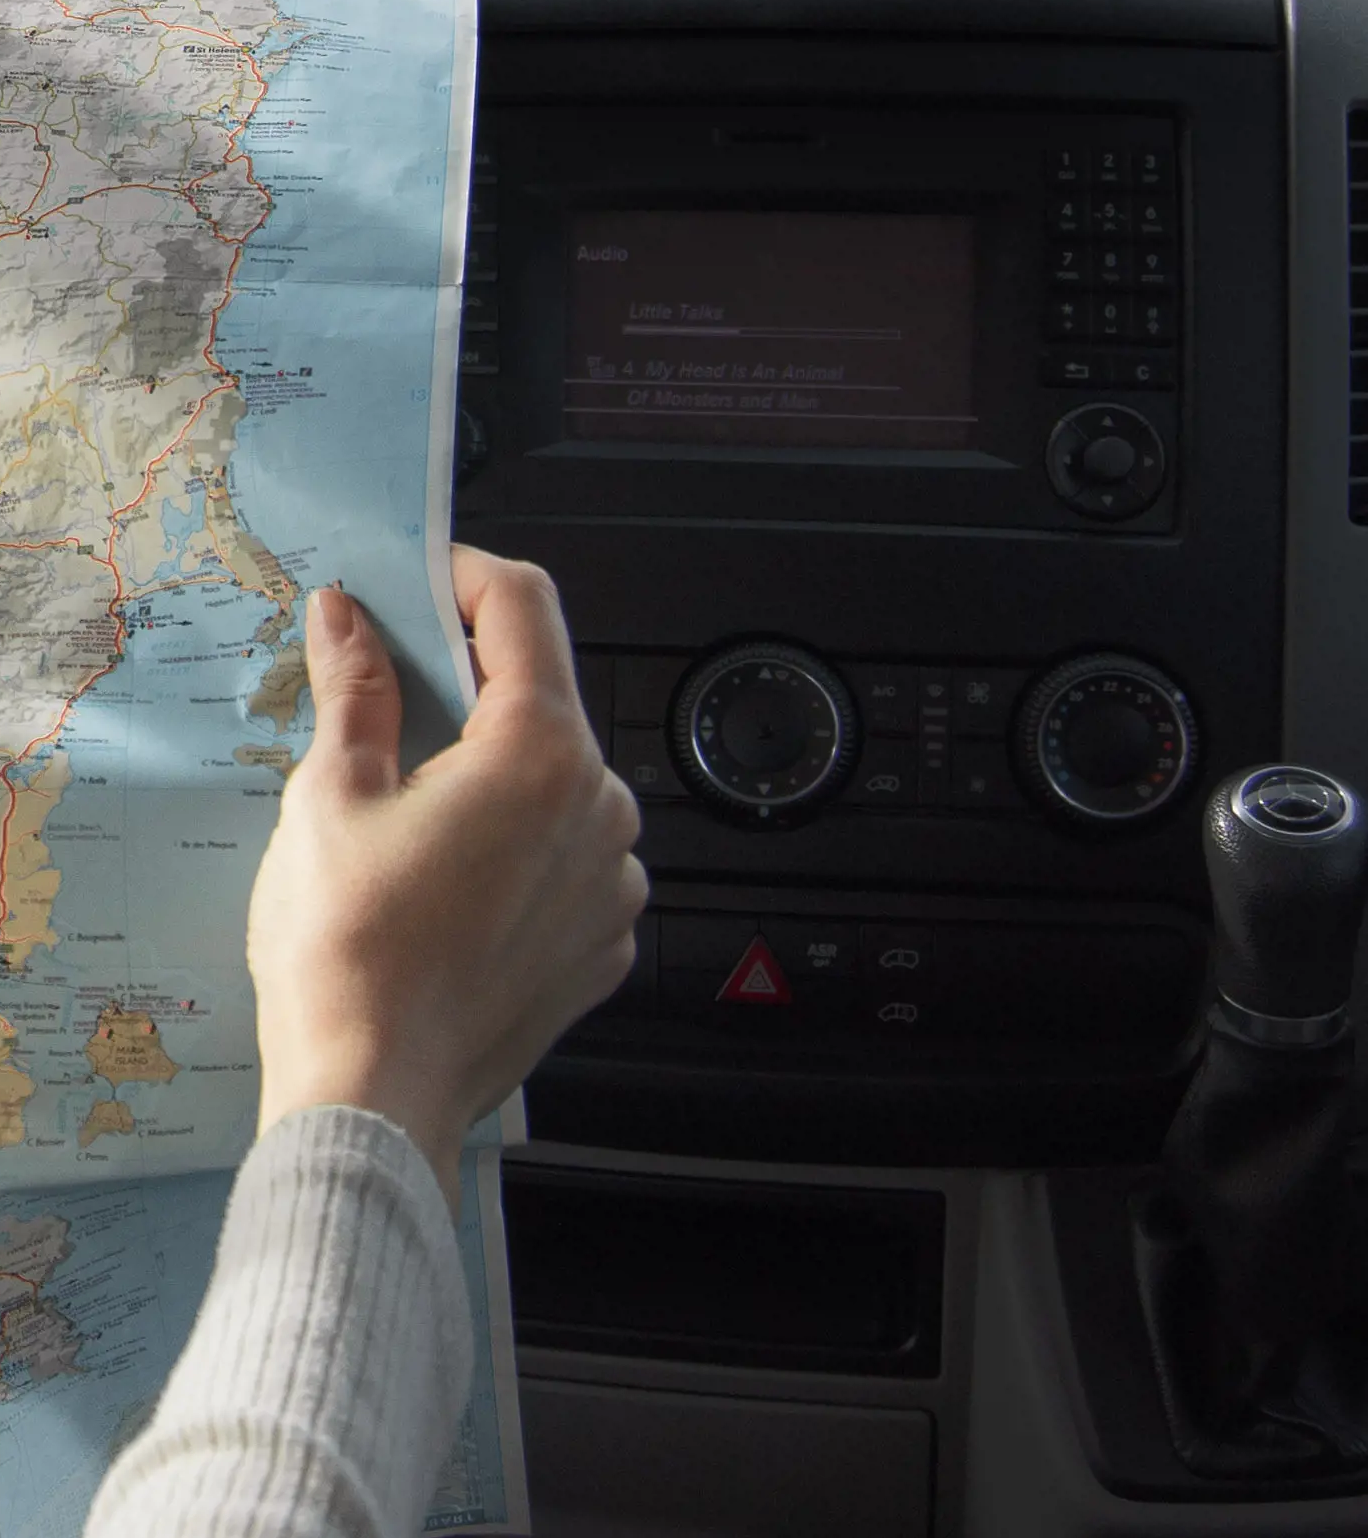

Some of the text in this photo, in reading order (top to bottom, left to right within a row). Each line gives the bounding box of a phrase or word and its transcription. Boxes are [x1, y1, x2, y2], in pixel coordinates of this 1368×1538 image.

[1061, 152, 1155, 169] 1 2 3
[1061, 203, 1156, 219] 4 5 6
[576, 244, 629, 263] Audio
[1062, 252, 1158, 269] 7 8 9
[629, 301, 725, 321] Little Talks
[1104, 304, 1117, 318] 0
[622, 361, 844, 382] 4 My Head Is An Animal
[1136, 366, 1150, 381] C
[626, 389, 820, 410] Of Monsters and Men
[194, 654, 219, 662] BEACH
[871, 685, 896, 697] A/C
[1102, 681, 1118, 692] 22
[1068, 690, 1084, 702] 20
[1136, 693, 1152, 704] 24
[807, 943, 837, 958] ASR
[116, 1046, 146, 1054] MARIA
[114, 1057, 148, 1065] ISLAND
[27, 1138, 34, 1147] C
[76, 1152, 83, 1161] C
